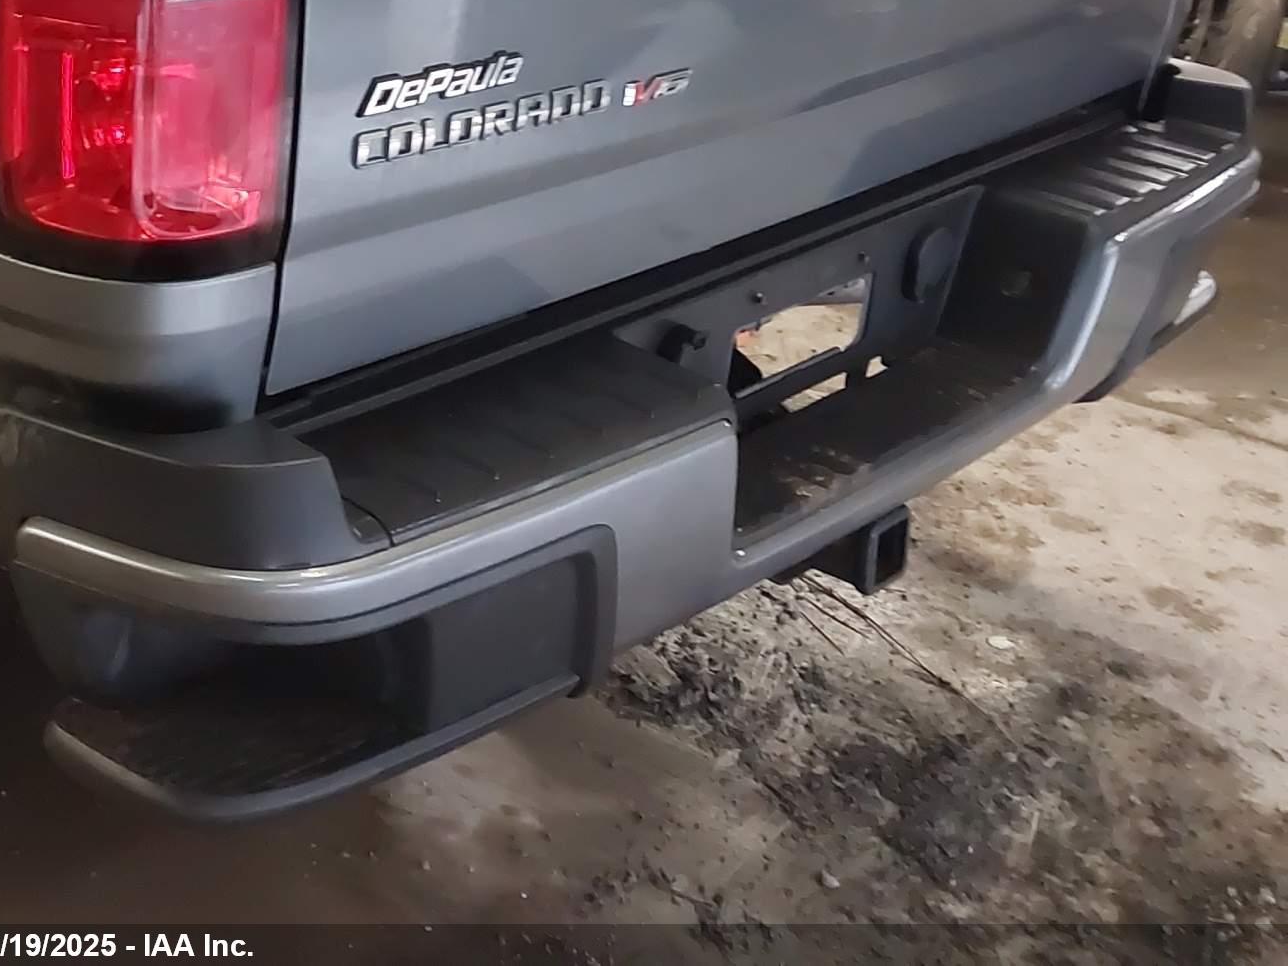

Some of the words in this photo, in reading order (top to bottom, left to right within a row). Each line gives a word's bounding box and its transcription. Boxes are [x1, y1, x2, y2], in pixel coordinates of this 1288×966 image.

[352, 79, 611, 169] COLORADO
[621, 67, 694, 108] V6
[355, 50, 524, 118] DePaula
